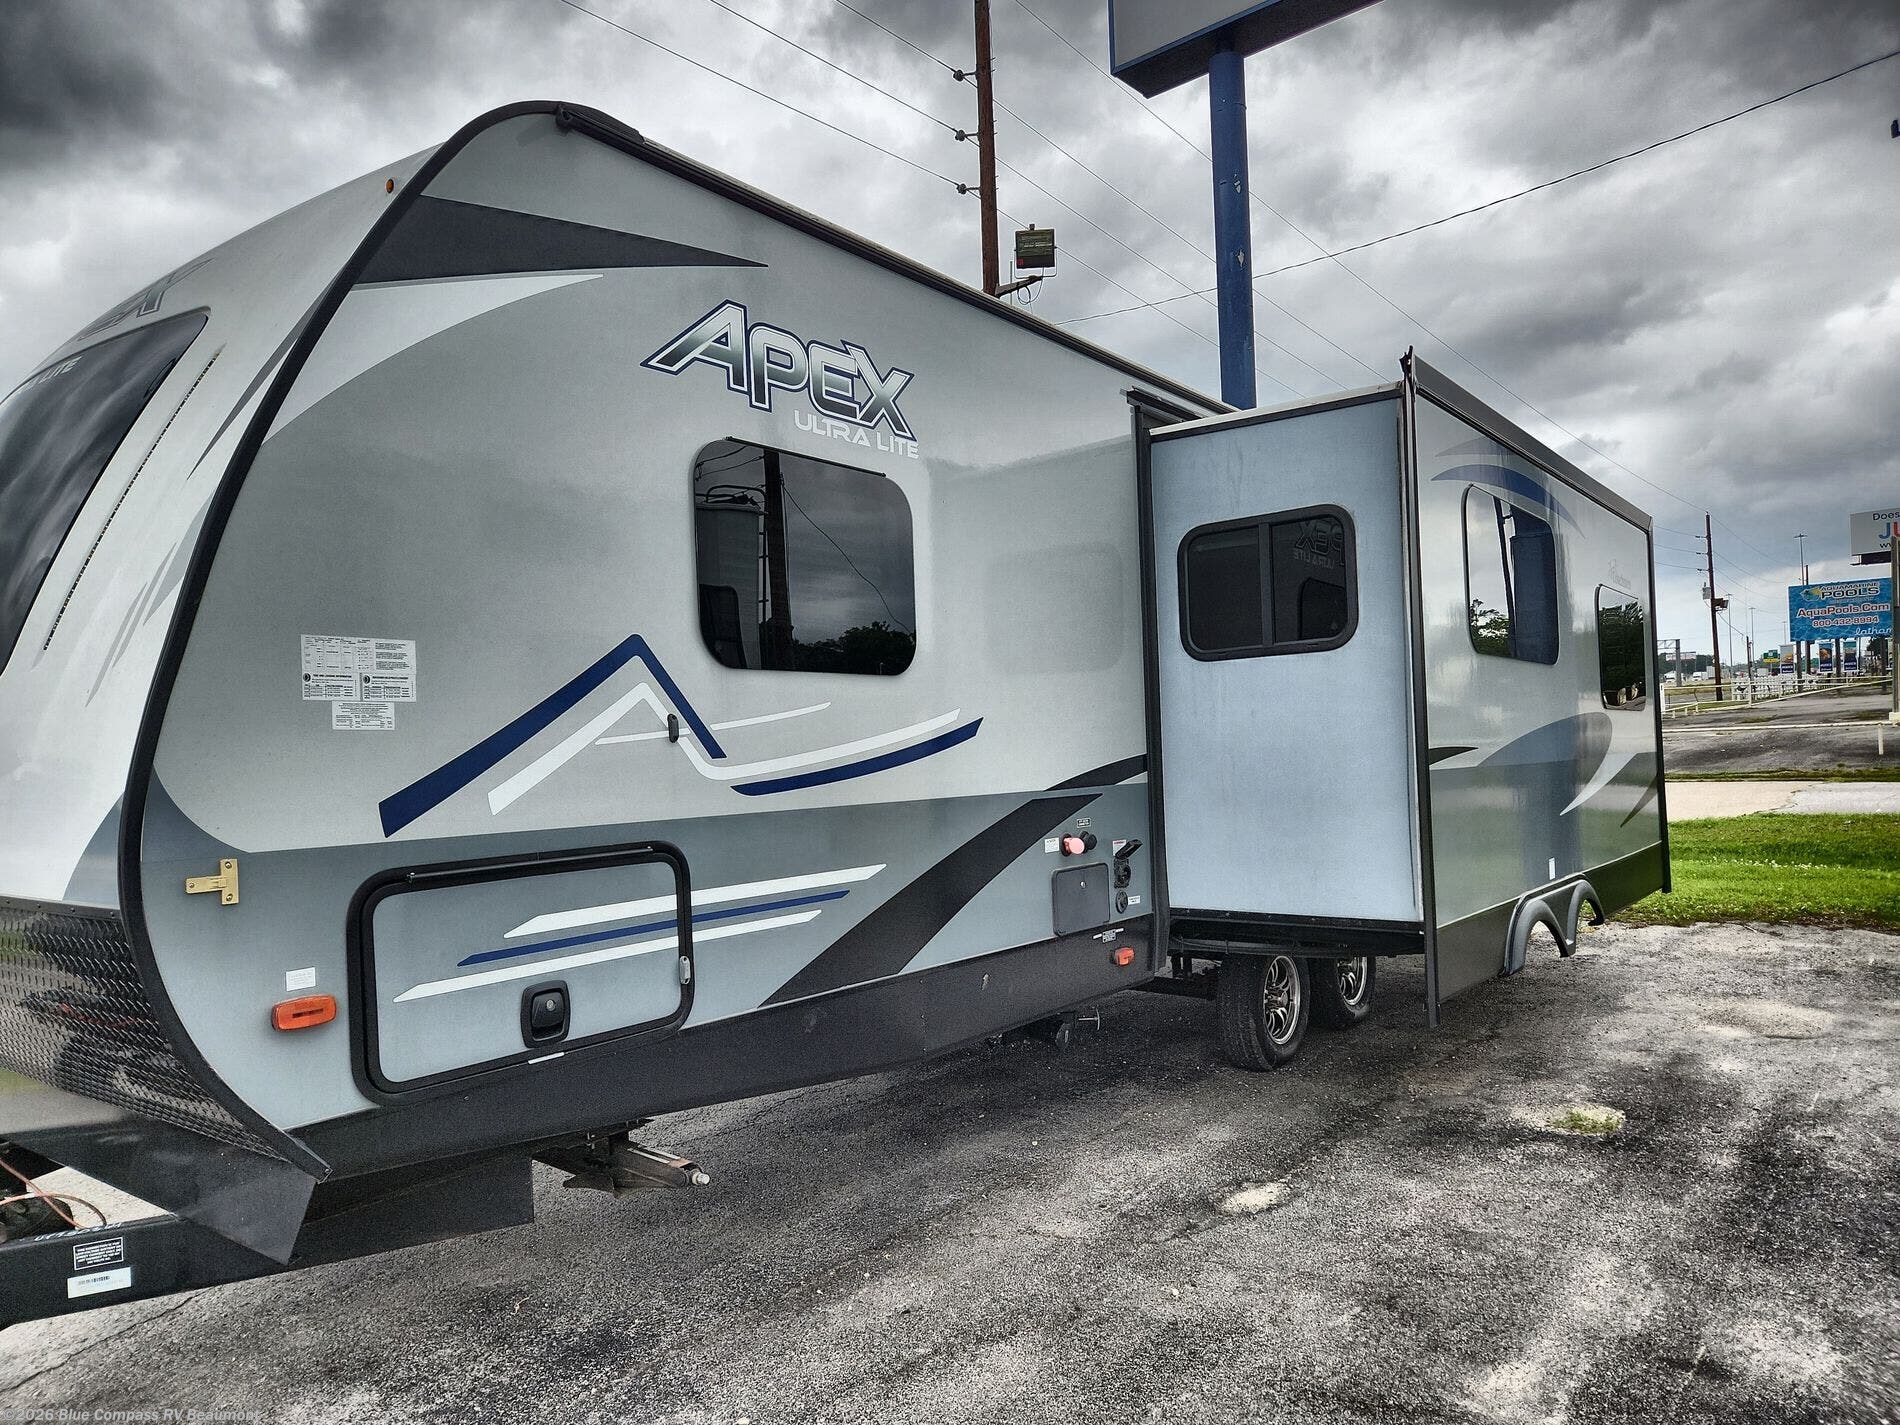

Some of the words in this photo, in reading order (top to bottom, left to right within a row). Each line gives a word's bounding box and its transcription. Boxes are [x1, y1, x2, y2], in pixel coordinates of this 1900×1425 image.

[640, 299, 917, 441] APEX
[794, 410, 870, 447] ULTRA
[877, 432, 919, 459] LITE
[1821, 587, 1880, 600] POOLS
[1797, 603, 1890, 619] AquaPools.Com
